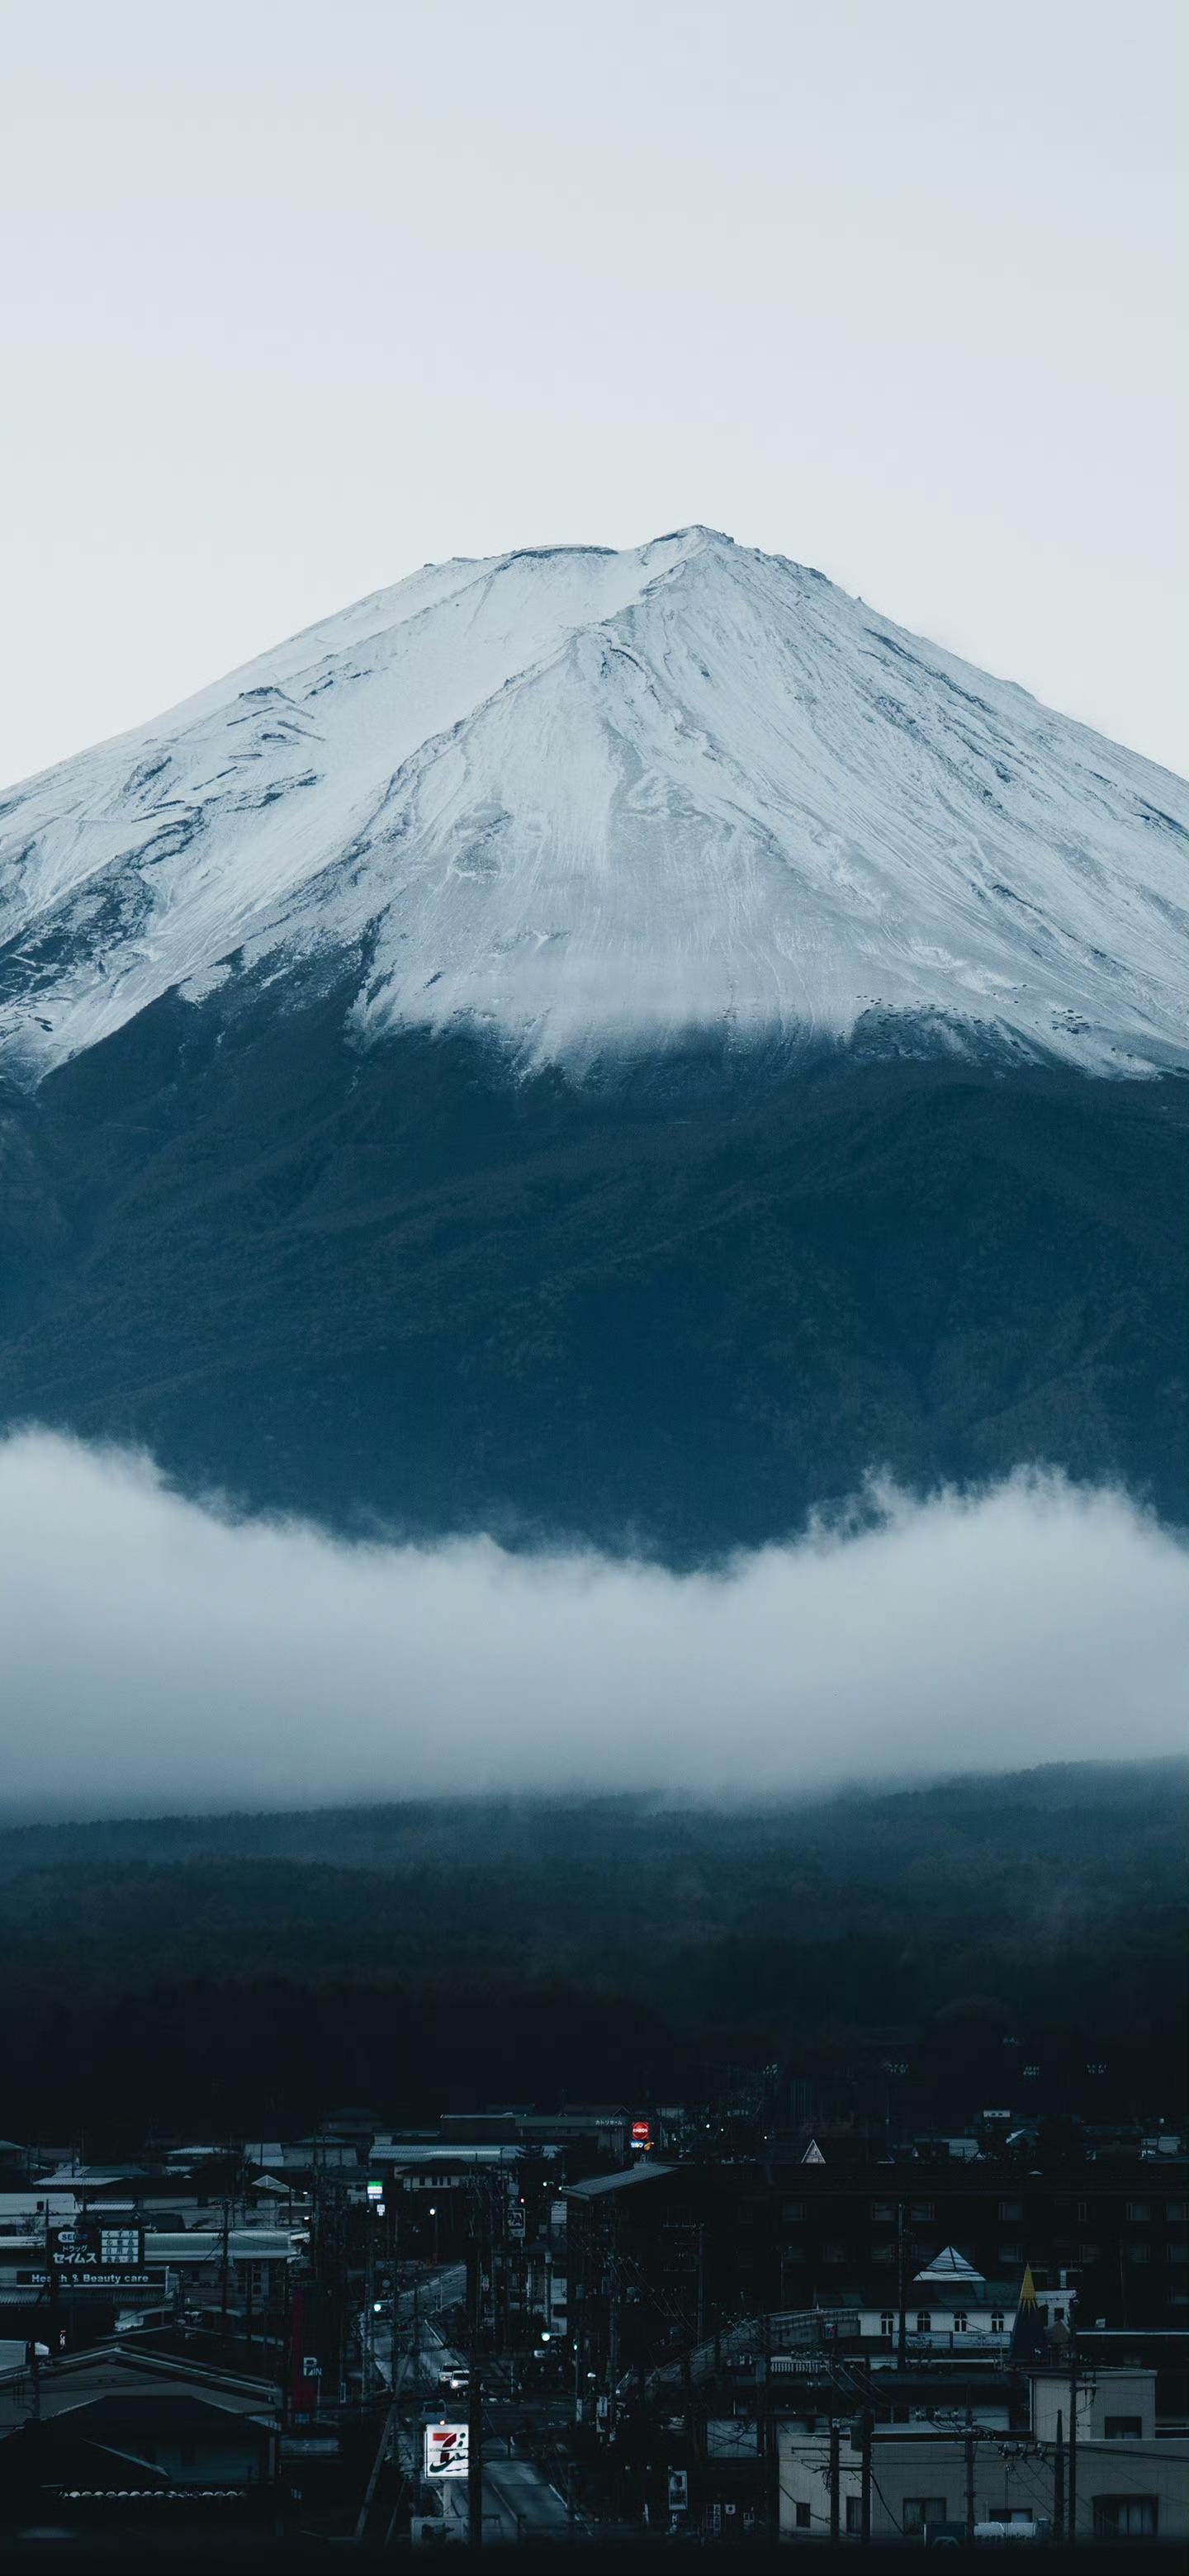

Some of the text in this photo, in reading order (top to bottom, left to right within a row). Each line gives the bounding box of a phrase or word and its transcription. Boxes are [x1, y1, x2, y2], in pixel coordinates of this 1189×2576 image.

[53, 2252, 97, 2264] セイムス
[31, 2274, 68, 2283] Heah
[72, 2274, 79, 2283] &
[83, 2274, 121, 2284] Beauty
